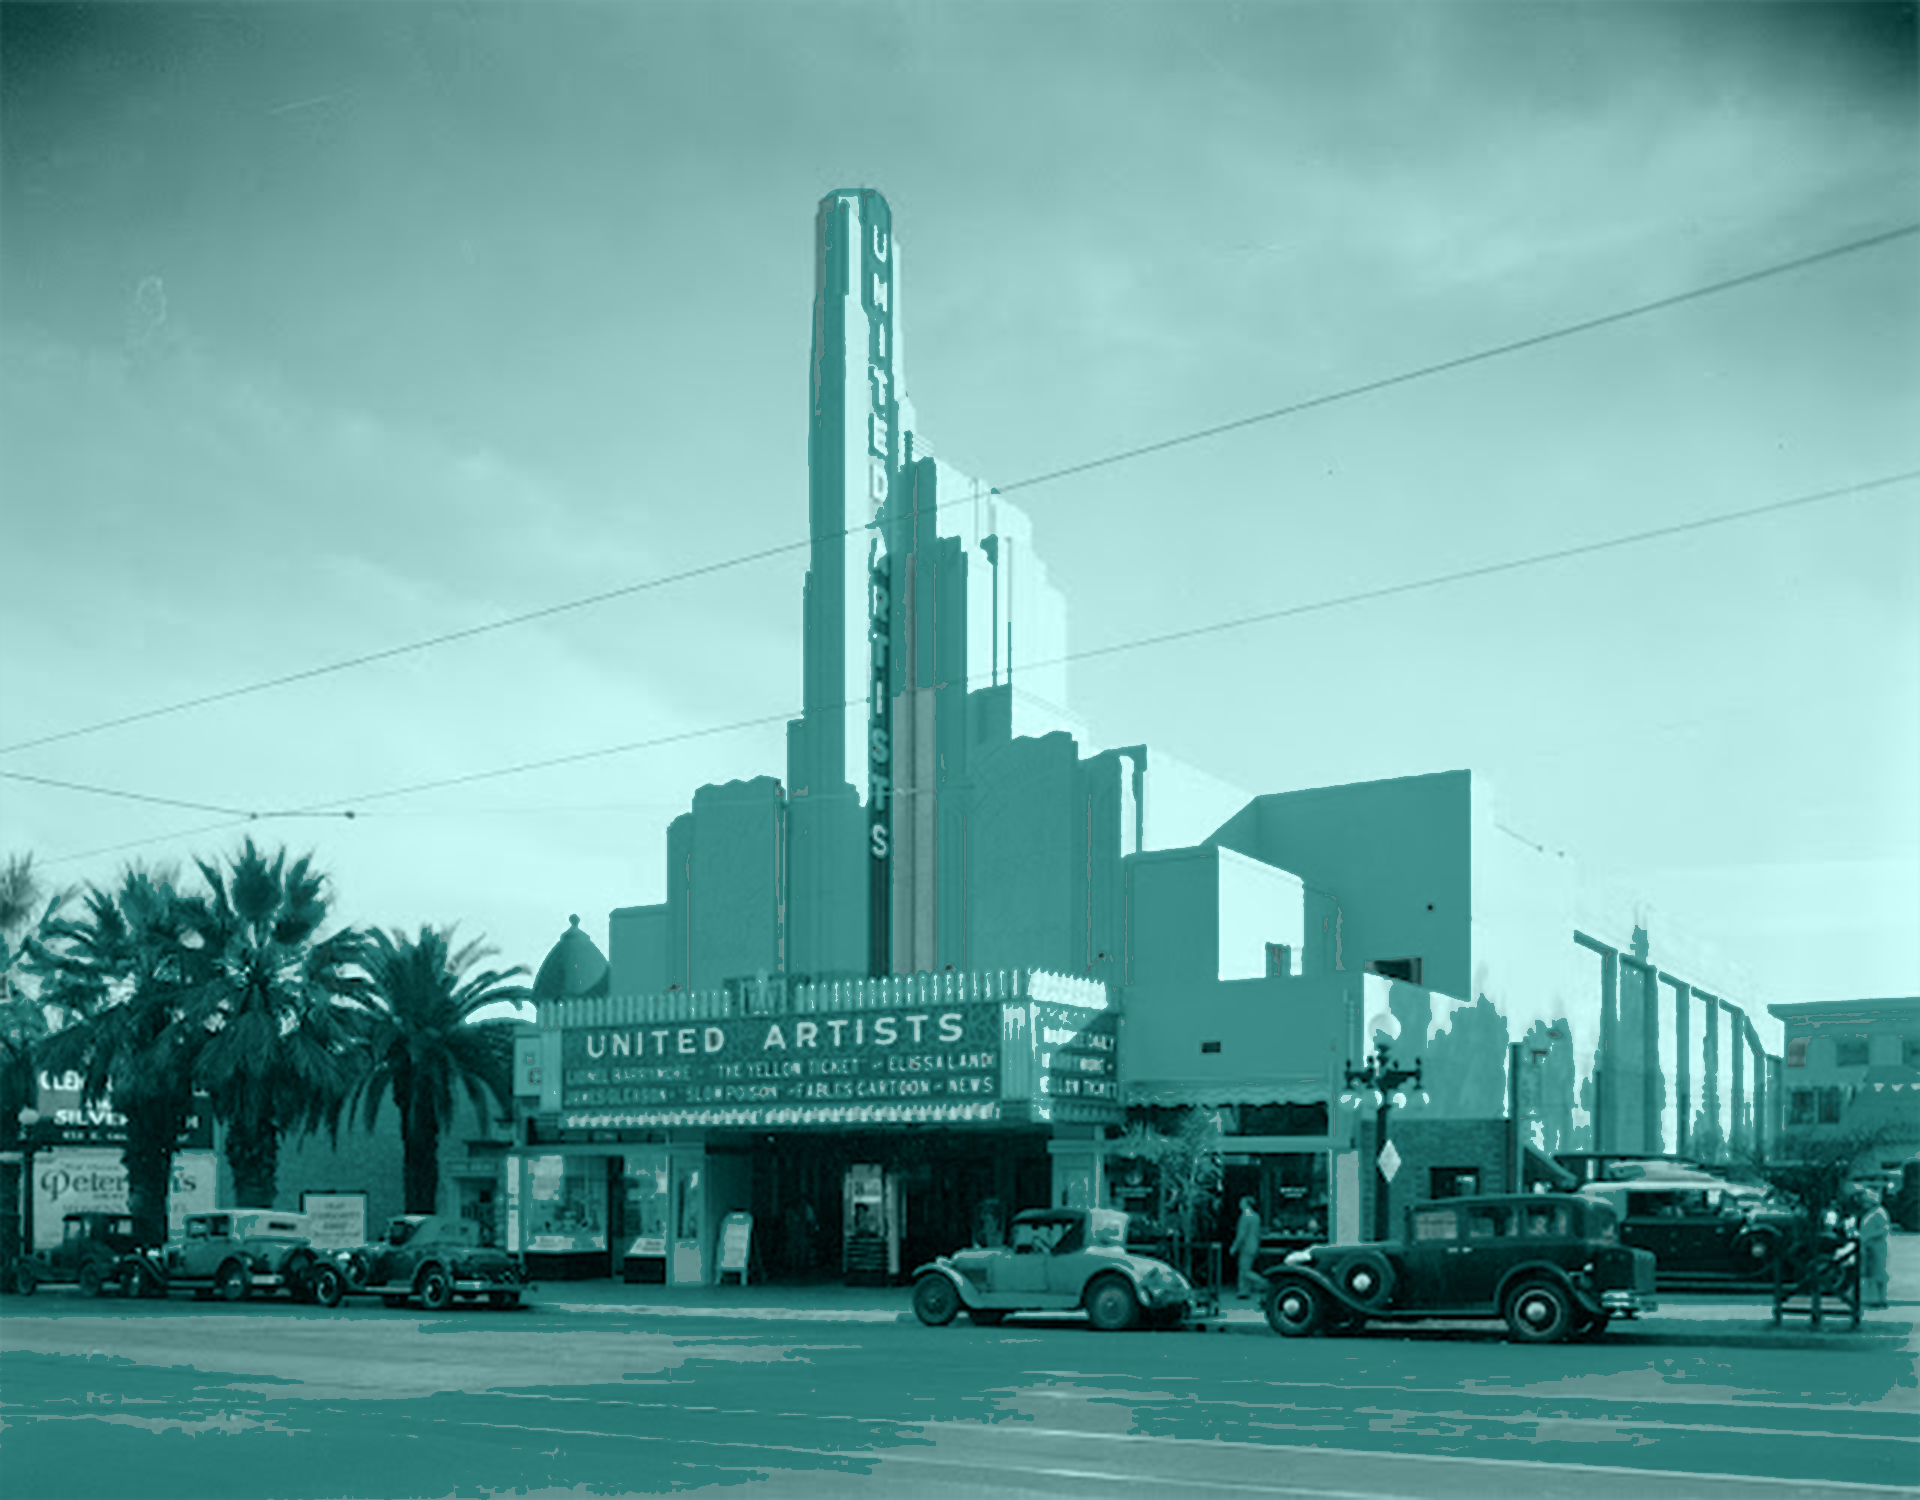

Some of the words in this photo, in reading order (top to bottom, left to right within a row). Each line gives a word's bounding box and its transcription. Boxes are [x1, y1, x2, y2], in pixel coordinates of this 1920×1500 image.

[872, 224, 888, 502] UNITED
[872, 534, 889, 858] ARTISTS
[587, 1027, 725, 1058] UNITED
[763, 1013, 963, 1050] ARTISTS
[746, 1060, 803, 1078] YELLOW
[856, 1078, 931, 1097] CARTOON
[947, 1075, 994, 1095] NEWS
